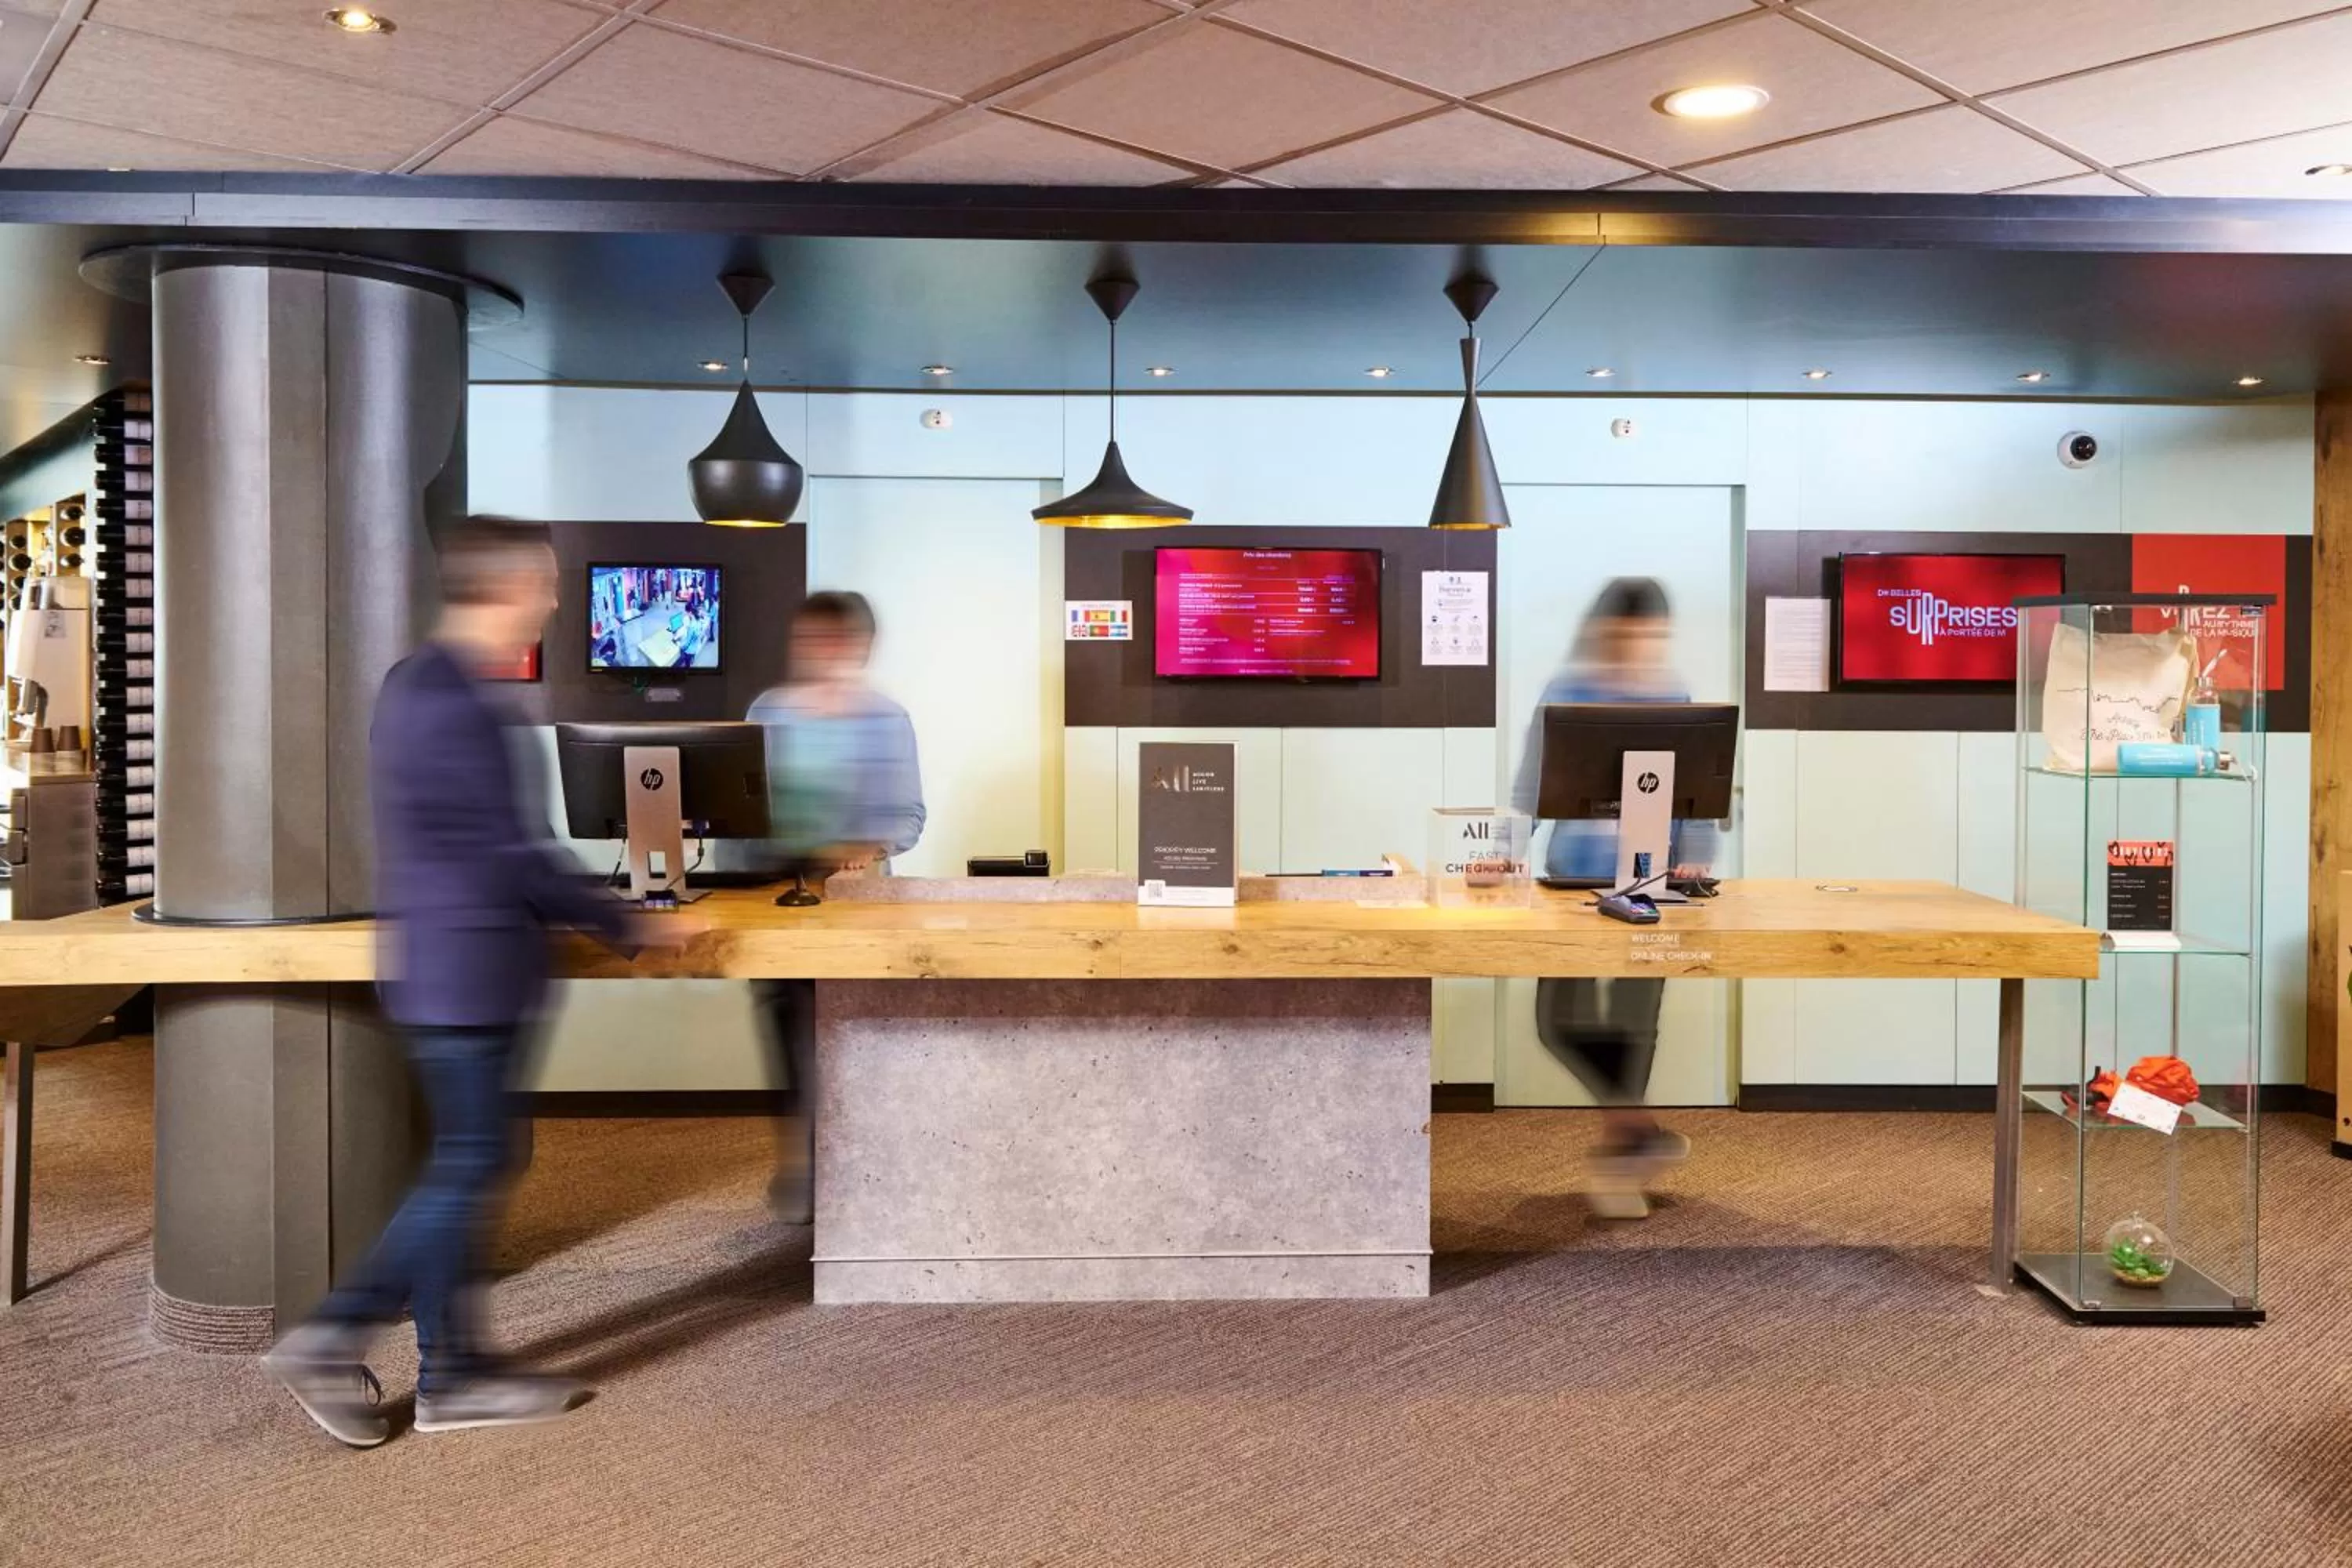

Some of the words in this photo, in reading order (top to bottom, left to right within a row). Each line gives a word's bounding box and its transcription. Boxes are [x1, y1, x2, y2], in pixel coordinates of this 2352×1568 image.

[1889, 592, 2017, 645] SURPRISES
[2190, 628, 2202, 637] DE
[2204, 628, 2216, 637] LA
[641, 768, 663, 791] hp
[1638, 772, 1659, 793] hp
[1463, 822, 1489, 840] All
[1469, 851, 1501, 861] FAST
